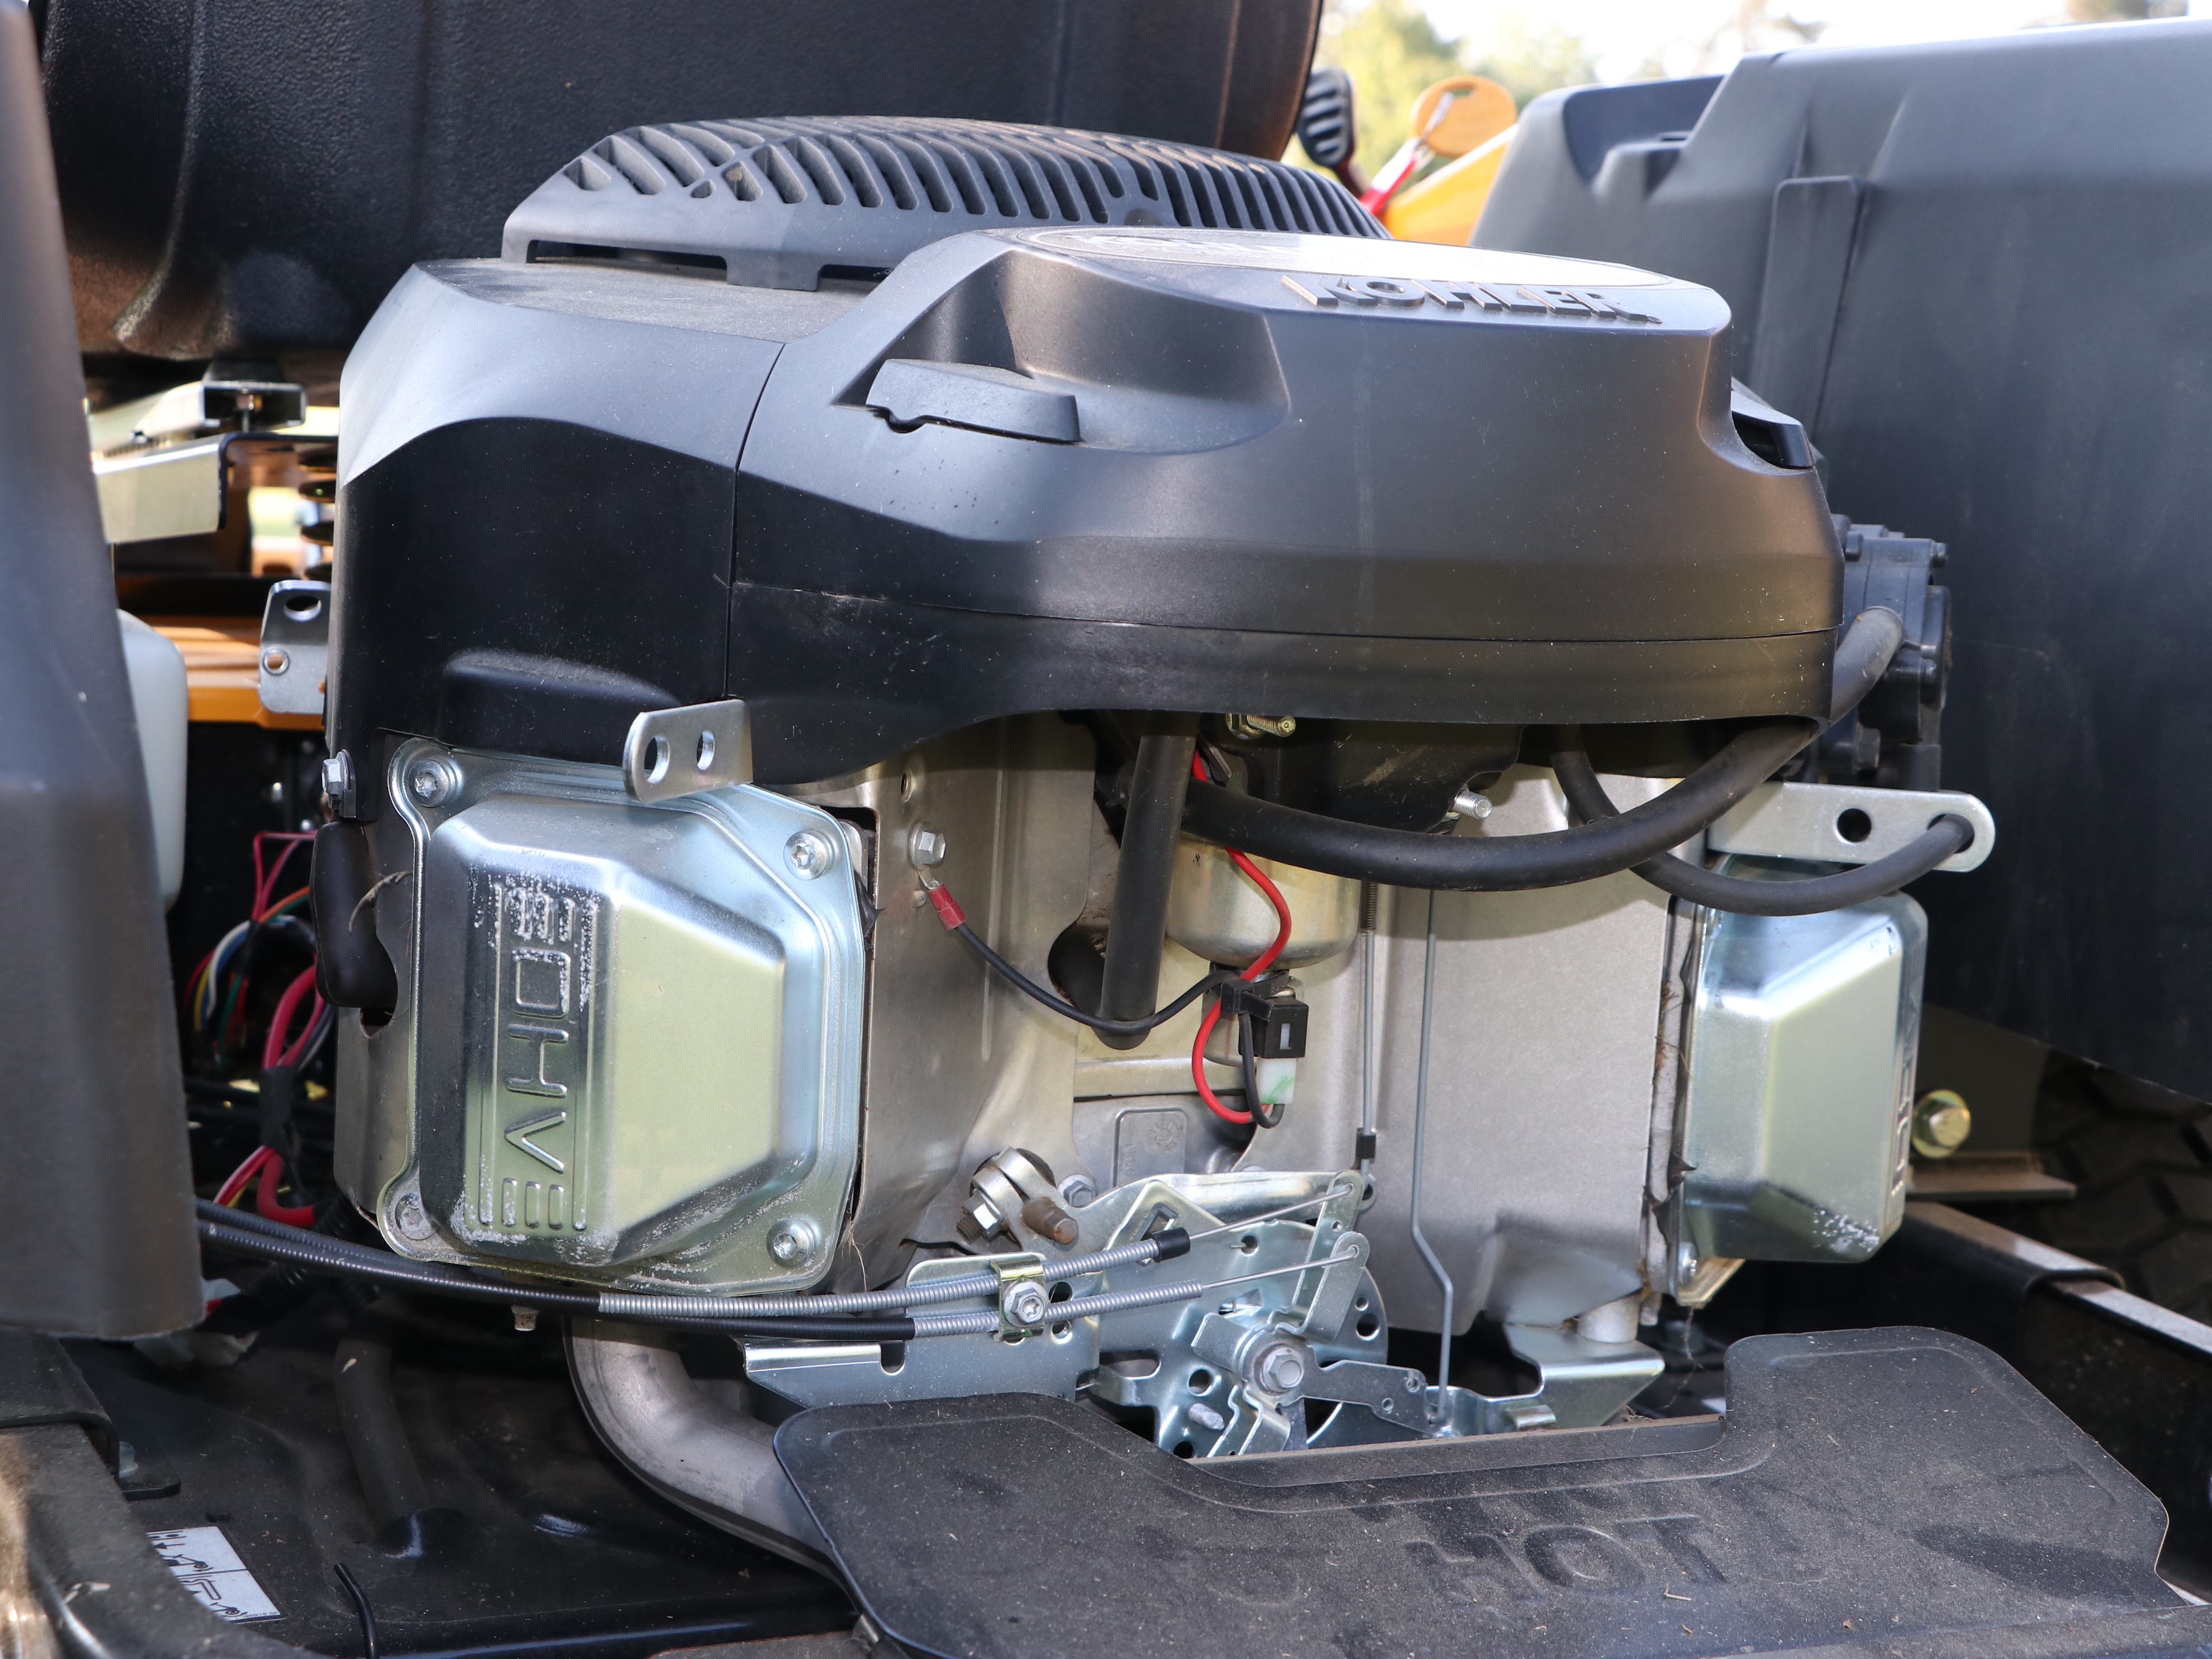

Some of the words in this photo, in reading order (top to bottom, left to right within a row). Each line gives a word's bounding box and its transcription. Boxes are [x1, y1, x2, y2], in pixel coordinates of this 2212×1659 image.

[1281, 273, 1650, 322] KOHLER
[503, 947, 571, 1175] OHV
[1402, 1514, 1728, 1612] HOT
